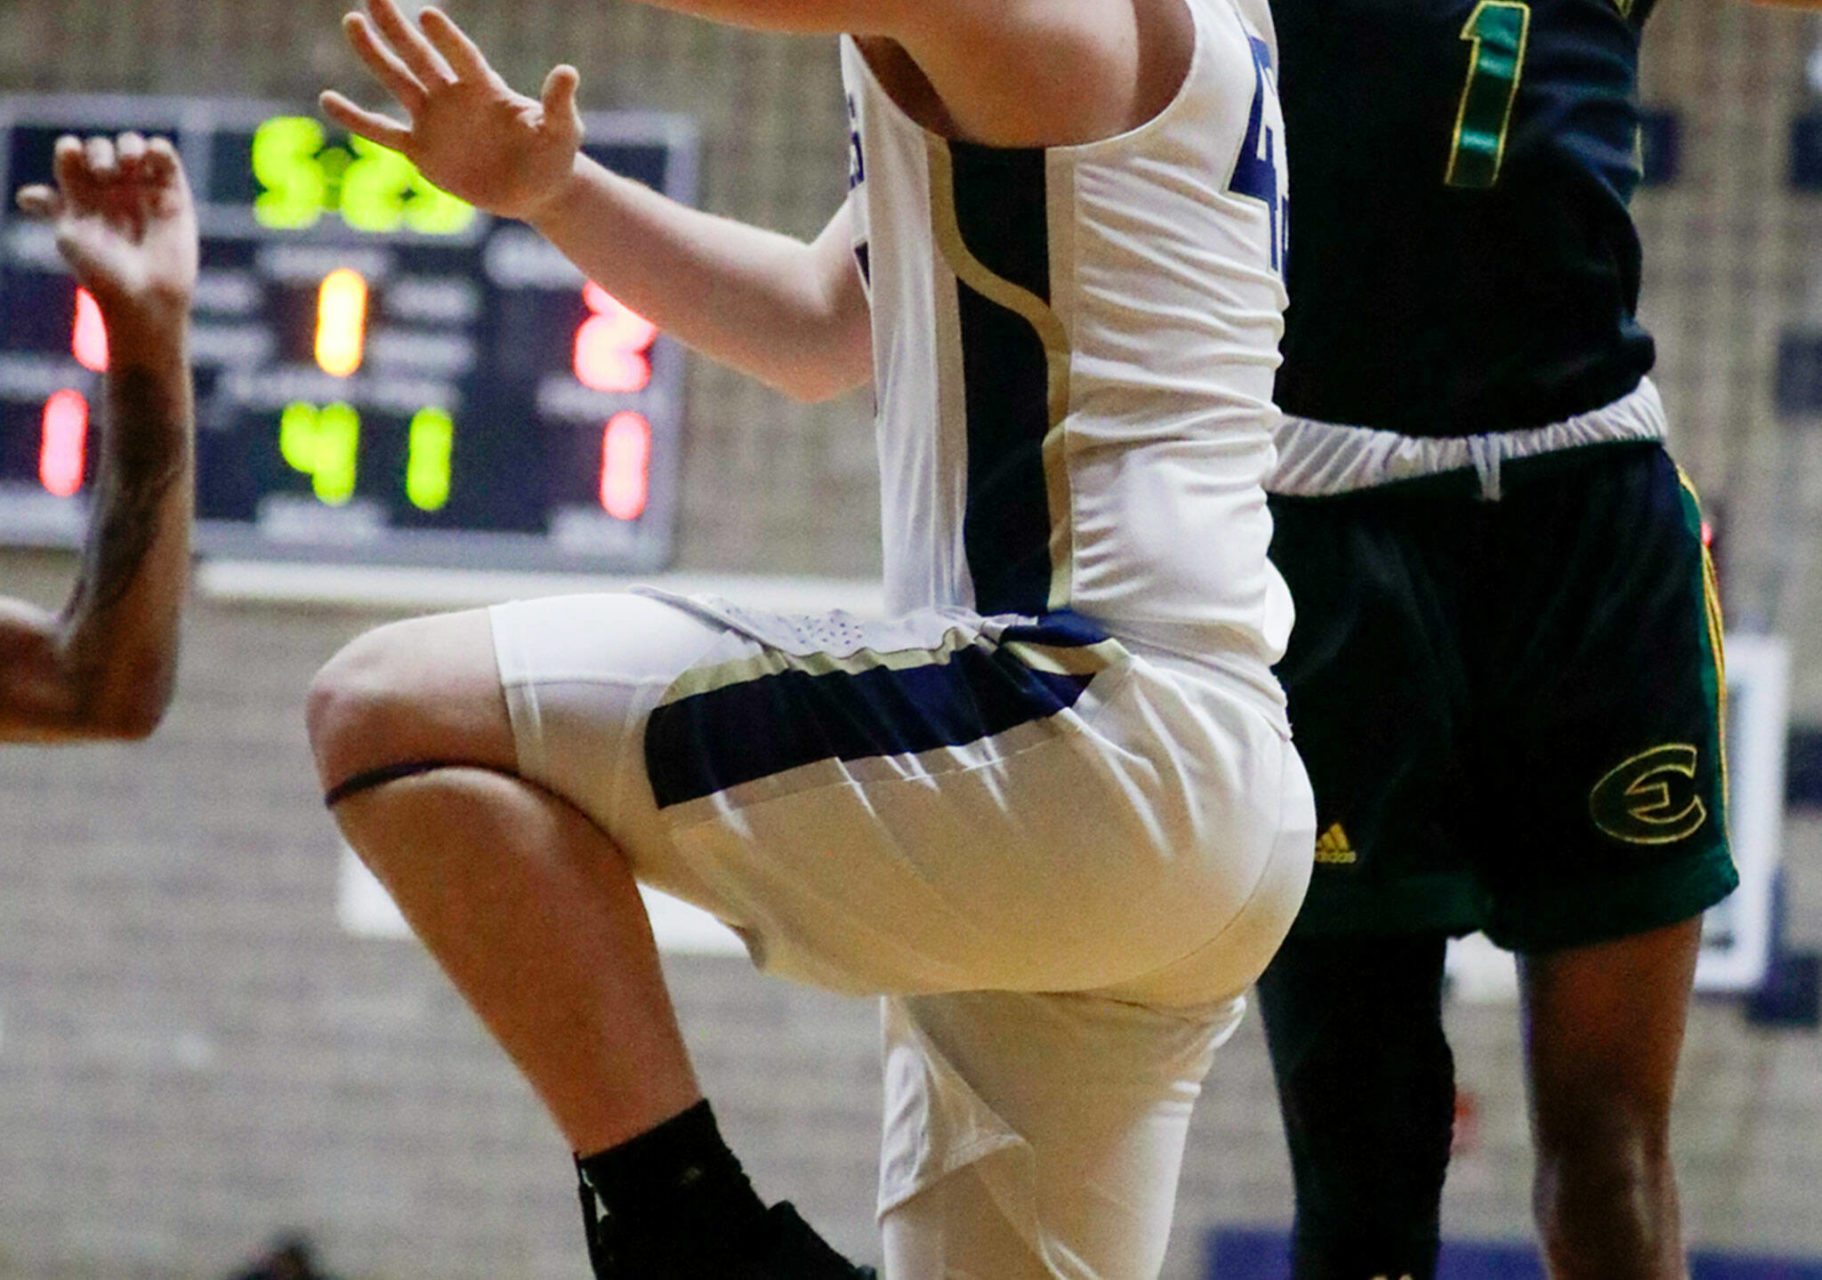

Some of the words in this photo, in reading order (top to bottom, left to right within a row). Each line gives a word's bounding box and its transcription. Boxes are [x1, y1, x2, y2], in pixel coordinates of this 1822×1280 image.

[315, 267, 369, 378] 1
[38, 387, 89, 497] 1
[599, 410, 651, 520] 1
